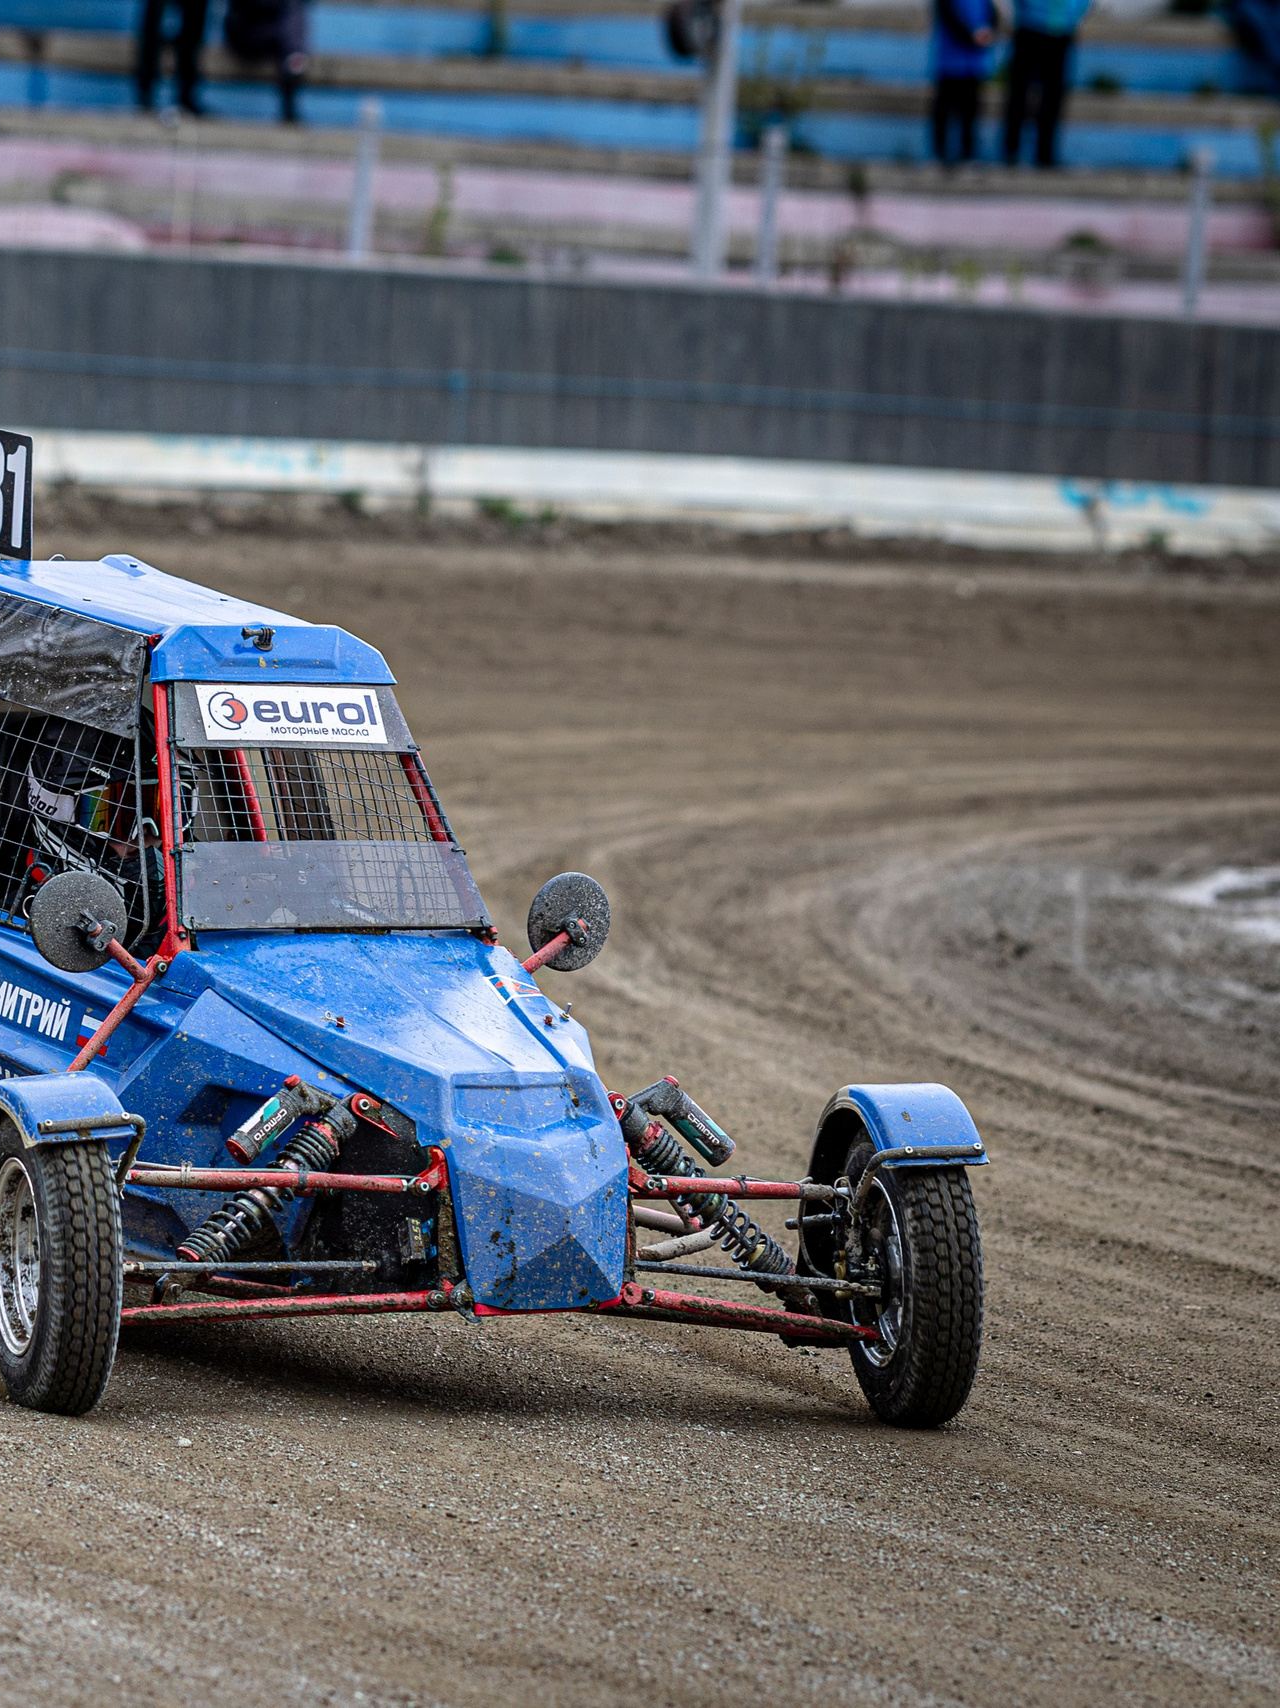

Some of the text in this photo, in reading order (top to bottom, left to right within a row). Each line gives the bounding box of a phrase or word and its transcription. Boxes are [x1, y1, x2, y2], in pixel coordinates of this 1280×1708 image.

[253, 694, 378, 726] eurol
[270, 726, 370, 737] моторные масла
[253, 1108, 288, 1141] CFMOTO
[687, 1112, 721, 1145] CFMOTO
